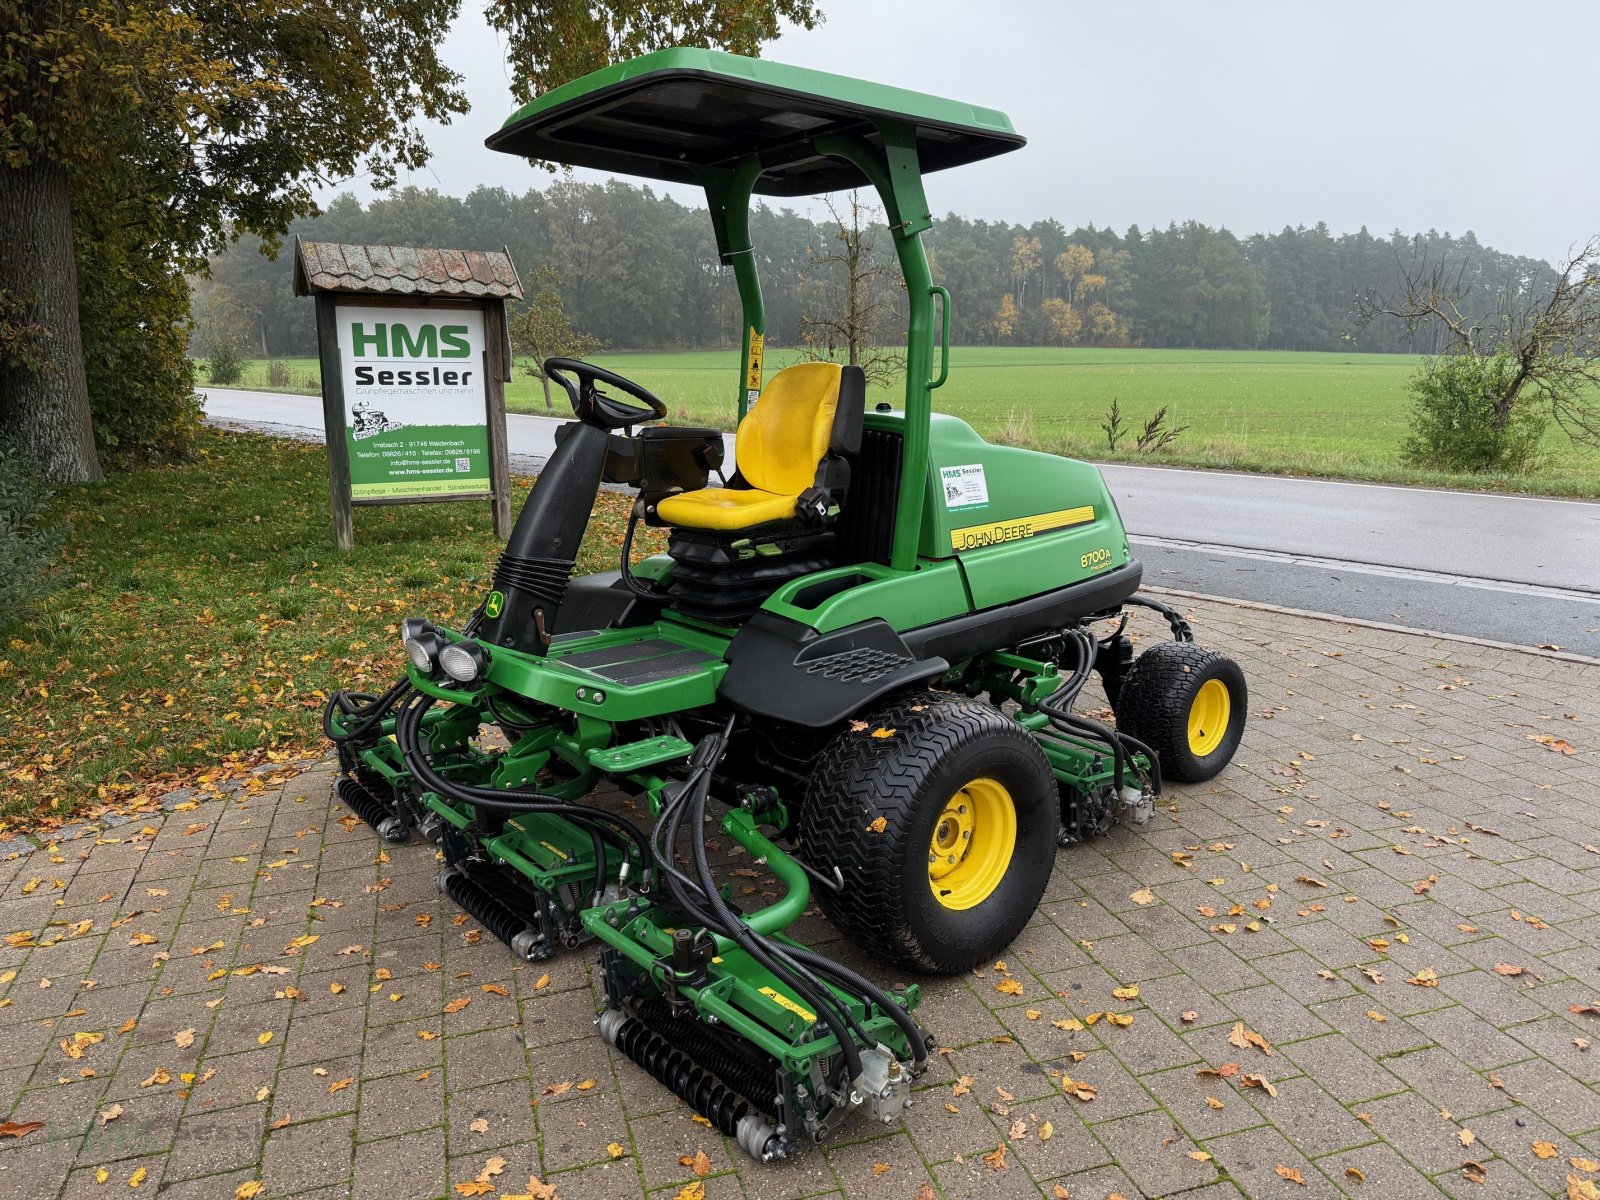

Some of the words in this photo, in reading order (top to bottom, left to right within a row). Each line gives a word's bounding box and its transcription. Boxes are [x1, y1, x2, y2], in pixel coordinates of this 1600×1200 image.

[351, 322, 471, 358] HMS
[354, 366, 473, 386] Sessler
[438, 387, 453, 395] und
[388, 467, 454, 476] www.hms-sessler.de
[942, 469, 962, 479] HMS
[958, 530, 995, 550] JOHN
[994, 523, 1033, 545] DEERE
[1080, 548, 1112, 568] 8700A
